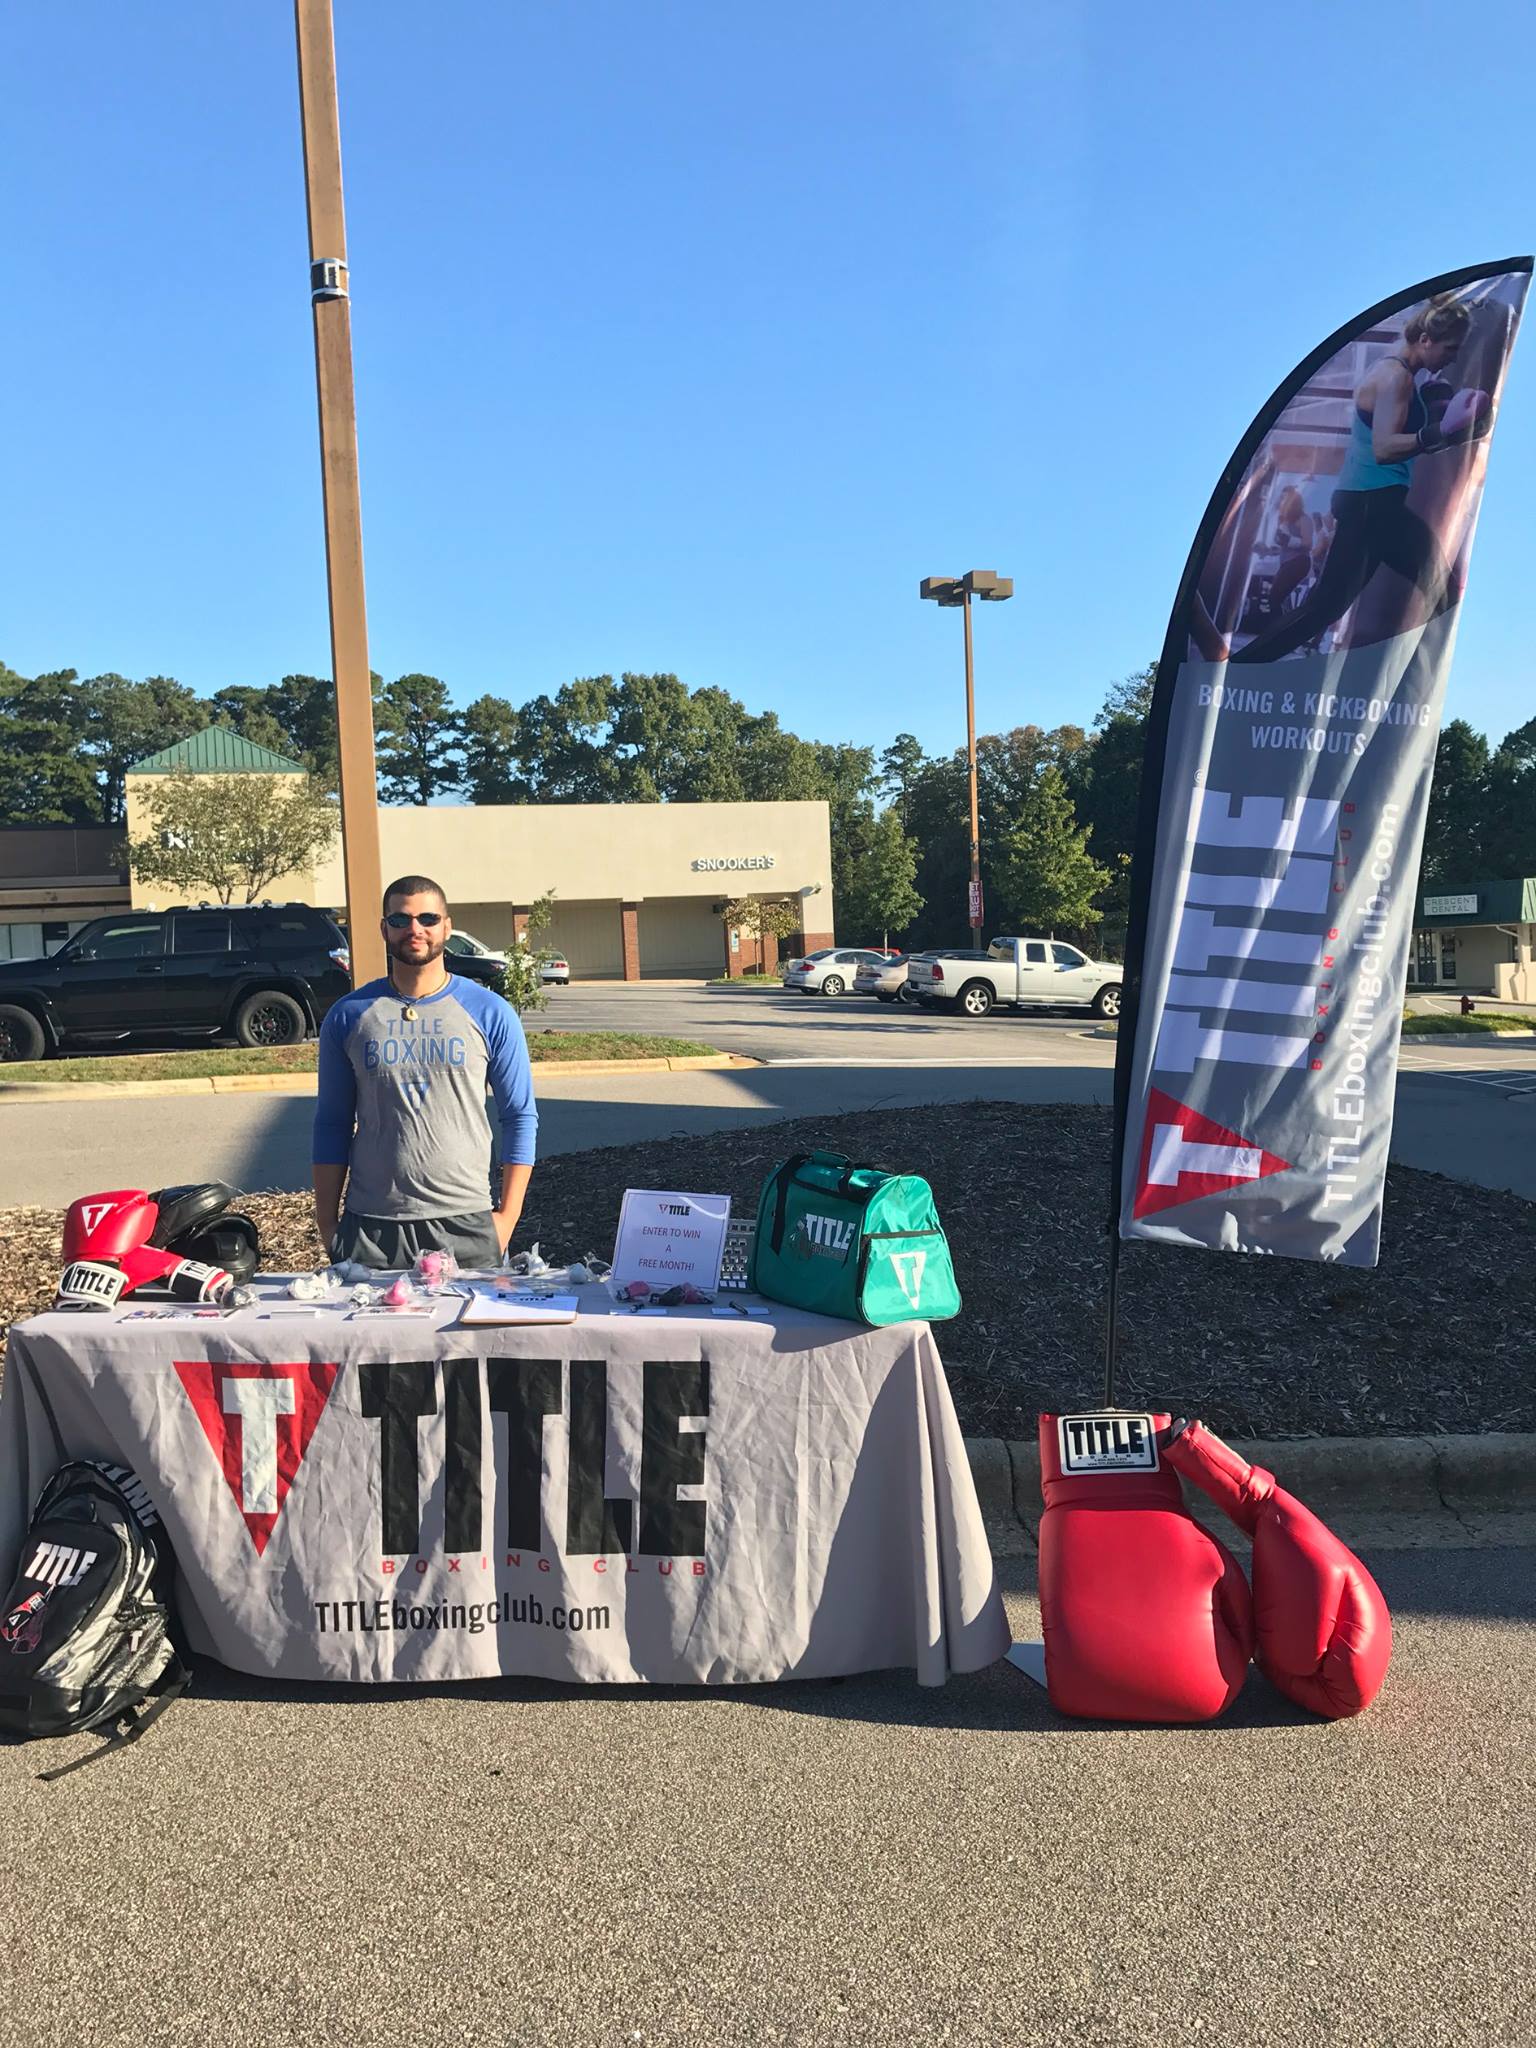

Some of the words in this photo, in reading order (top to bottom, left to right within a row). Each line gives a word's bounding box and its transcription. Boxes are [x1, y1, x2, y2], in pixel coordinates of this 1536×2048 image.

[1198, 684, 1274, 714] BOXING
[1281, 691, 1296, 714] &
[1304, 692, 1431, 727] KICKBOXING
[1251, 726, 1367, 756] WORKOUTS
[696, 856, 777, 871] SNOOKER'S
[1424, 896, 1476, 906] CRESCENT
[1431, 905, 1471, 913] DENTAL
[1154, 787, 1340, 1072] TITLE
[1311, 928, 1339, 1070] BOXING
[1333, 802, 1356, 893] CLUB
[1322, 803, 1400, 1208] TITLEboxingclub.com
[387, 1018, 443, 1036] TITLE
[364, 1036, 466, 1071] BOXING
[1148, 1123, 1263, 1187] T
[669, 1204, 691, 1216] TITLE
[642, 1226, 668, 1237] ENTER
[670, 1228, 681, 1238] TO
[683, 1229, 701, 1239] WIN
[804, 1212, 856, 1251] TITLE
[638, 1258, 658, 1269] FREE
[660, 1260, 695, 1271] MONTH!
[665, 1244, 672, 1253] A
[73, 1269, 118, 1296] TITLE
[1068, 1420, 1145, 1456] TITLE
[221, 1377, 297, 1514] T
[358, 1357, 710, 1557] TITLE
[24, 1541, 98, 1587] TITLE
[381, 1553, 551, 1575] BOXING
[593, 1558, 706, 1577] CLUB
[315, 1594, 610, 1634] TITLEboxingclub.com
